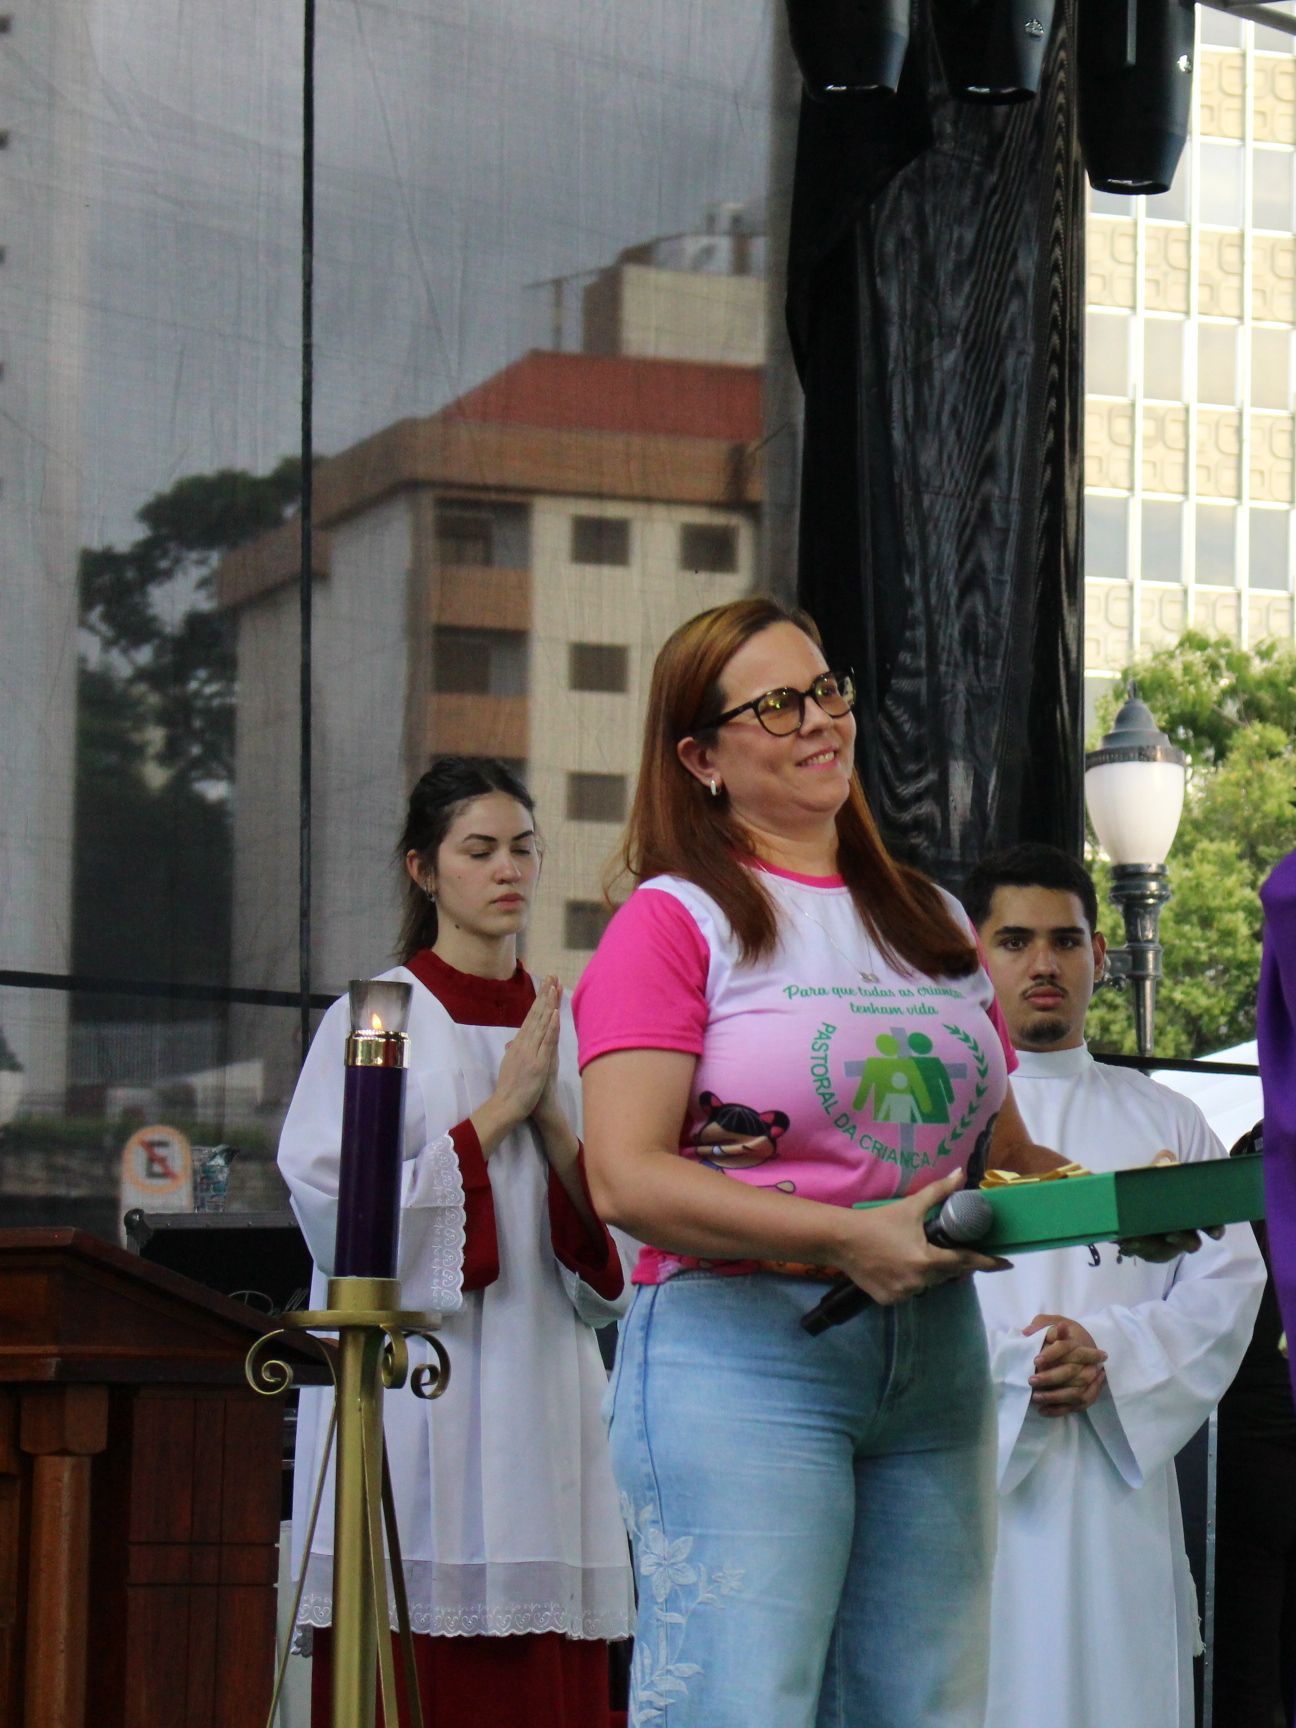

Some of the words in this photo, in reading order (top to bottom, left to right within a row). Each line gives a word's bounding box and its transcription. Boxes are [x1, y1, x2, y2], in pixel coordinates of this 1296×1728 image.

[783, 984, 828, 1000] Para
[832, 986, 853, 999] que
[857, 986, 896, 998] todas
[898, 987, 914, 998] as
[917, 985, 966, 999] crian
[850, 1002, 903, 1015] tenham
[906, 1003, 938, 1016] vida
[810, 1022, 839, 1116] PASTORAL
[834, 1113, 857, 1140] DA
[859, 1134, 933, 1170] CRIANÇA
